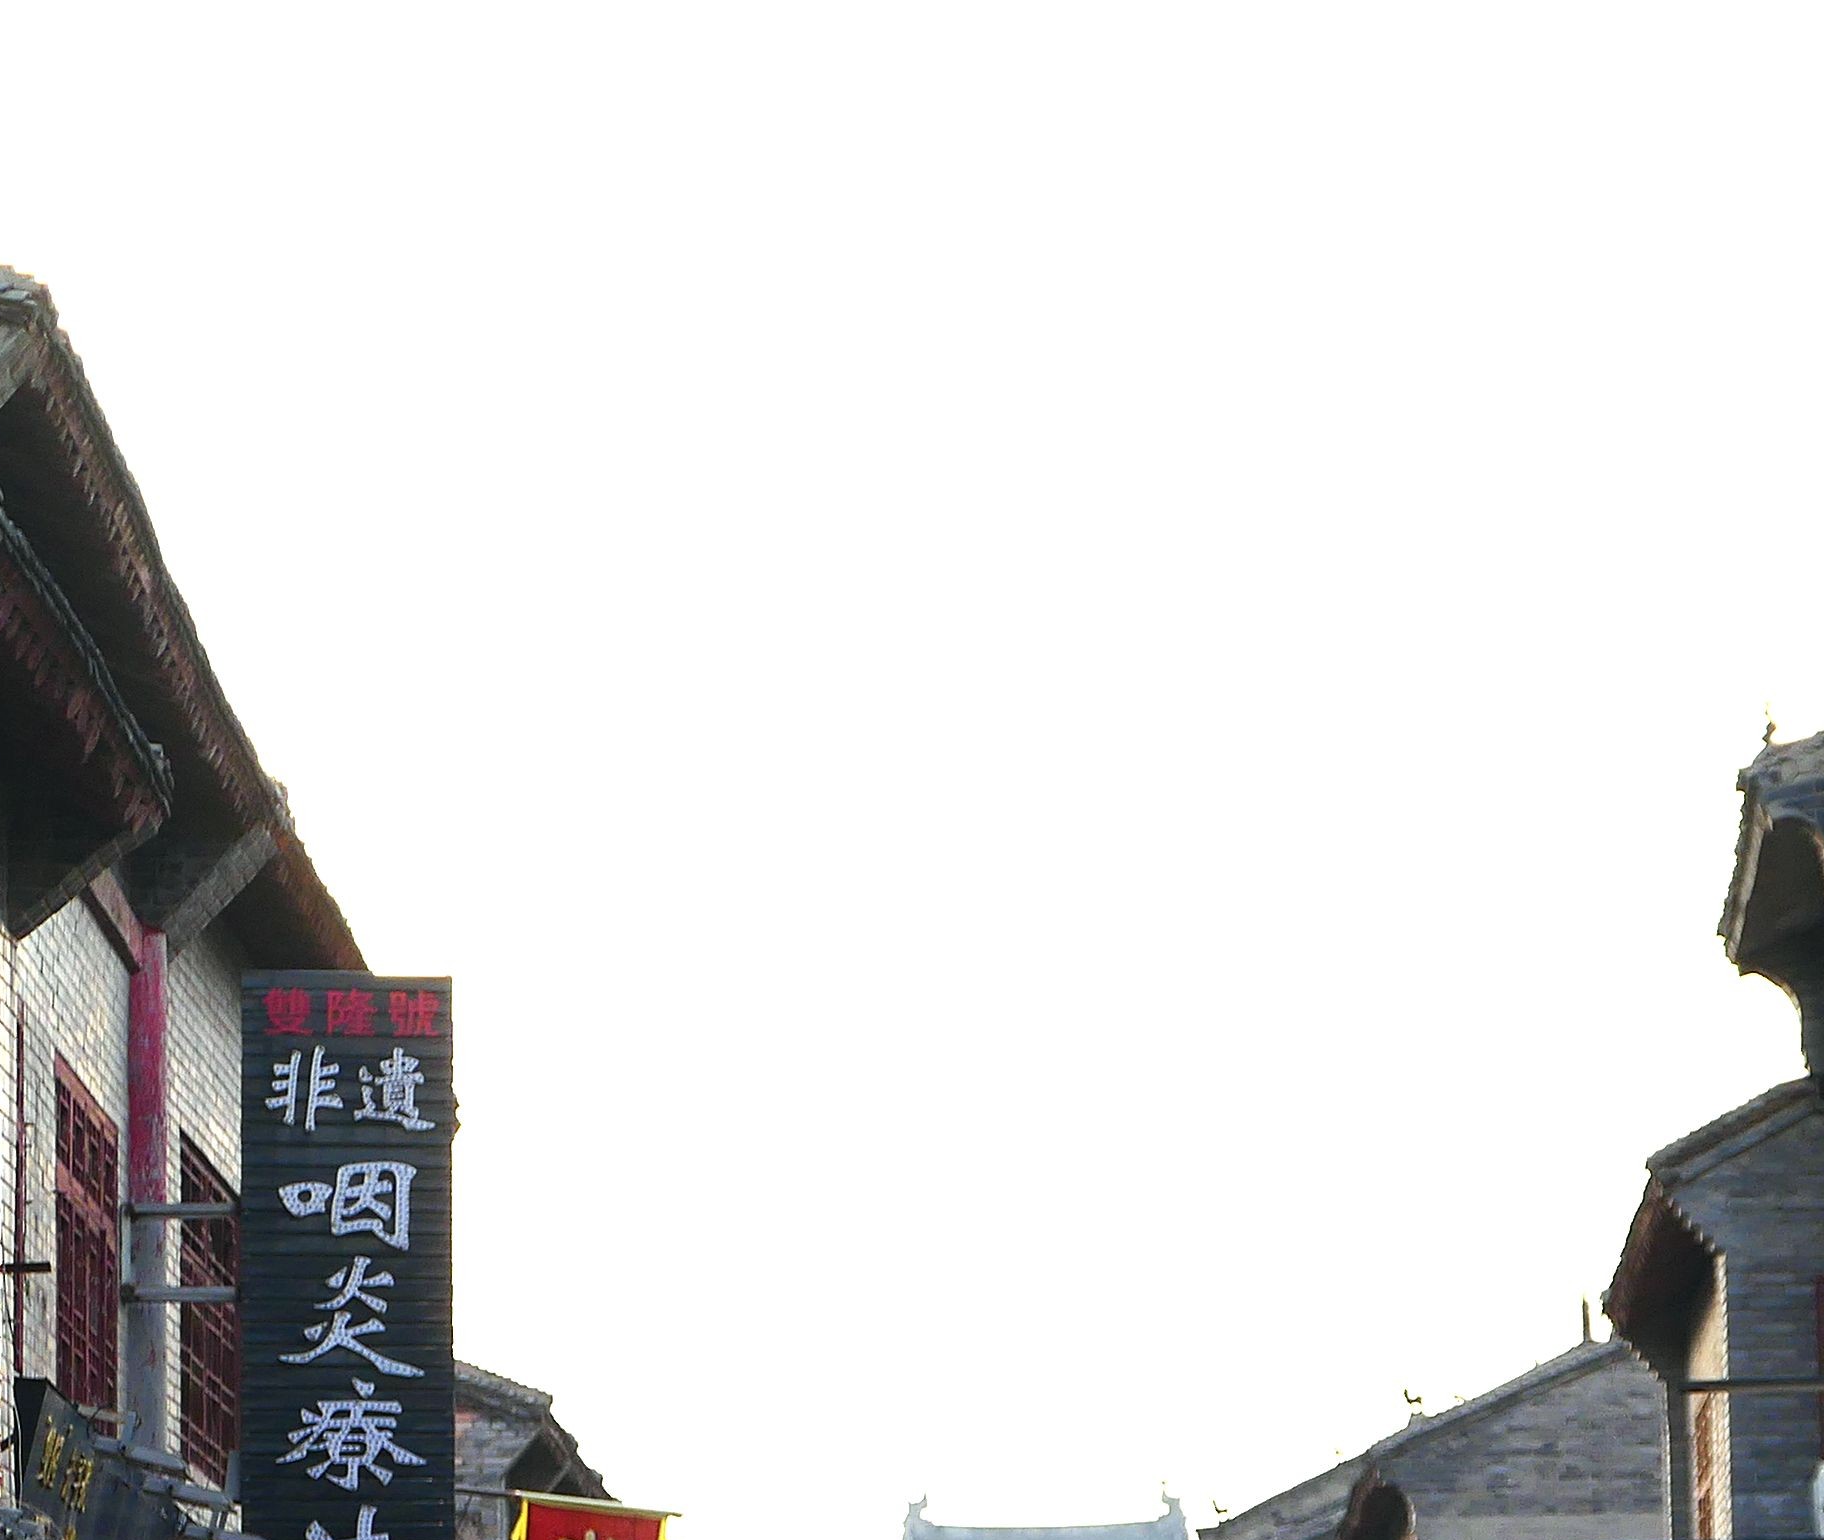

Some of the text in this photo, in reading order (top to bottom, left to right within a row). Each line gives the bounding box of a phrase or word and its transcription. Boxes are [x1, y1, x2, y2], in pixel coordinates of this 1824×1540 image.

[264, 987, 441, 1038] 雙隆號
[264, 1044, 437, 1133] 非遺
